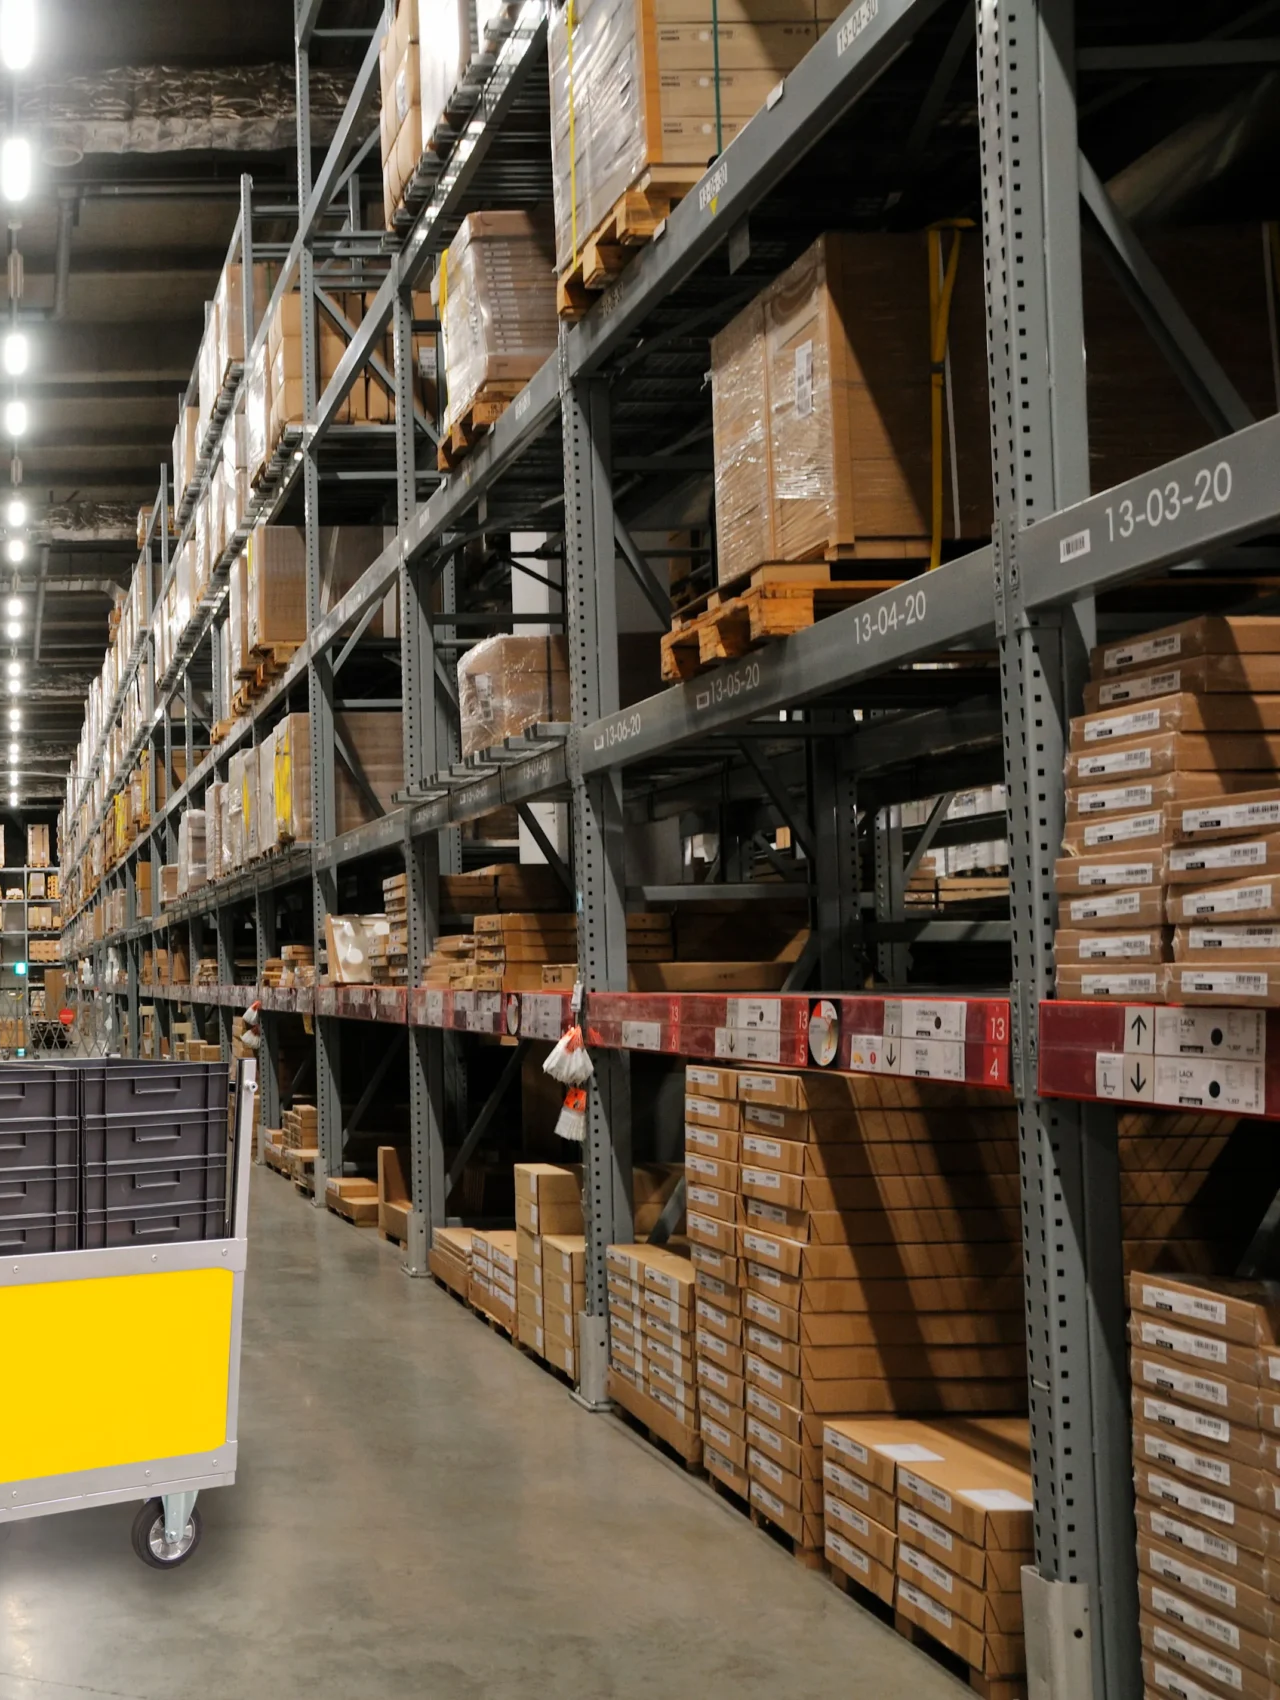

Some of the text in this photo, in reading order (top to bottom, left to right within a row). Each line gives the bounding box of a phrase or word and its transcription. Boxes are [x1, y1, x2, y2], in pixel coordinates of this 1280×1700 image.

[838, 0, 878, 53] 13-04-30
[1105, 461, 1233, 543] 13-03-20
[853, 589, 927, 645] 13-04-20
[709, 662, 760, 705] 13-05-20
[604, 712, 641, 748] 13-06-20
[671, 1005, 679, 1022] 13
[798, 1010, 808, 1030] 13
[1180, 1019, 1195, 1027] LACK
[990, 1017, 1005, 1041] 13
[799, 1045, 805, 1062] 5
[989, 1058, 999, 1080] 4
[1179, 1070, 1194, 1078] LACK
